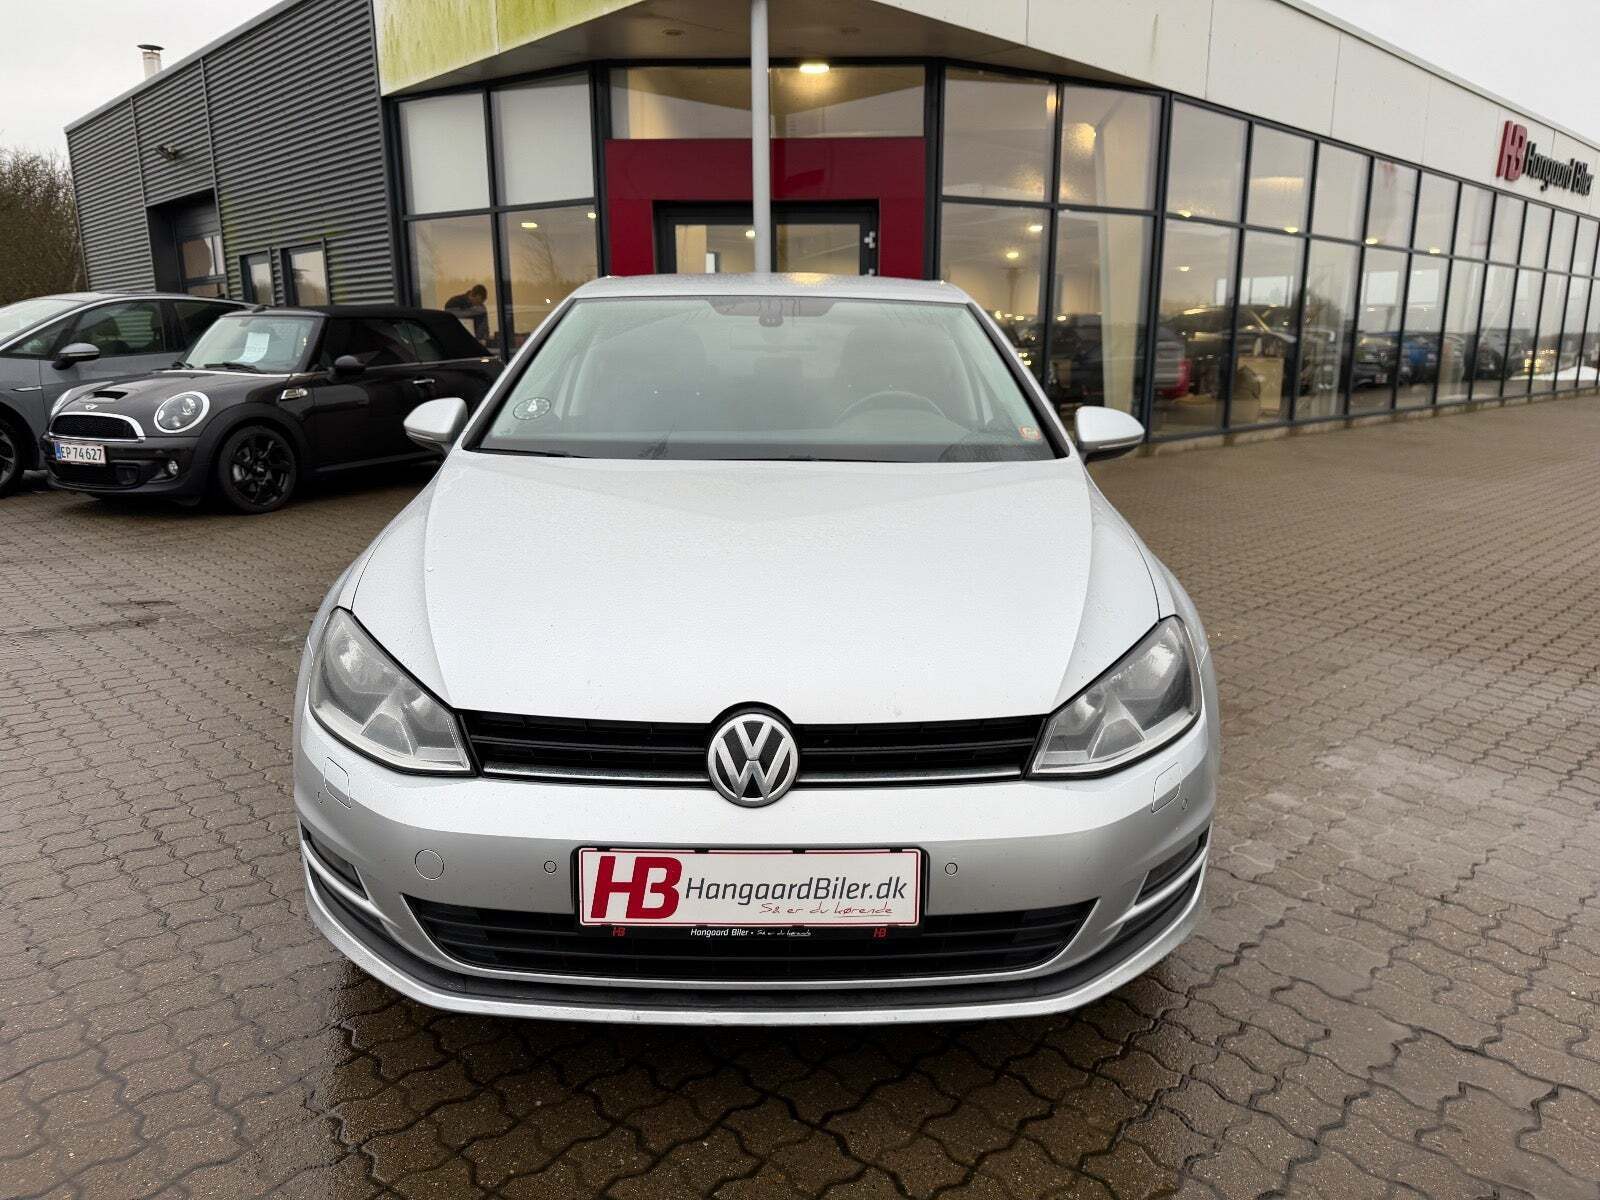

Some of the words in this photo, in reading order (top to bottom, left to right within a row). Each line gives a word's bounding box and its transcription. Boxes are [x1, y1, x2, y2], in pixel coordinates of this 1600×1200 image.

[1496, 120, 1527, 181] HB
[590, 855, 682, 919] HB
[685, 876, 908, 906] HangaardBiler.dk
[787, 907, 804, 915] er
[809, 901, 830, 915] du
[690, 928, 729, 937] Hangaard
[731, 929, 749, 937] Biler
